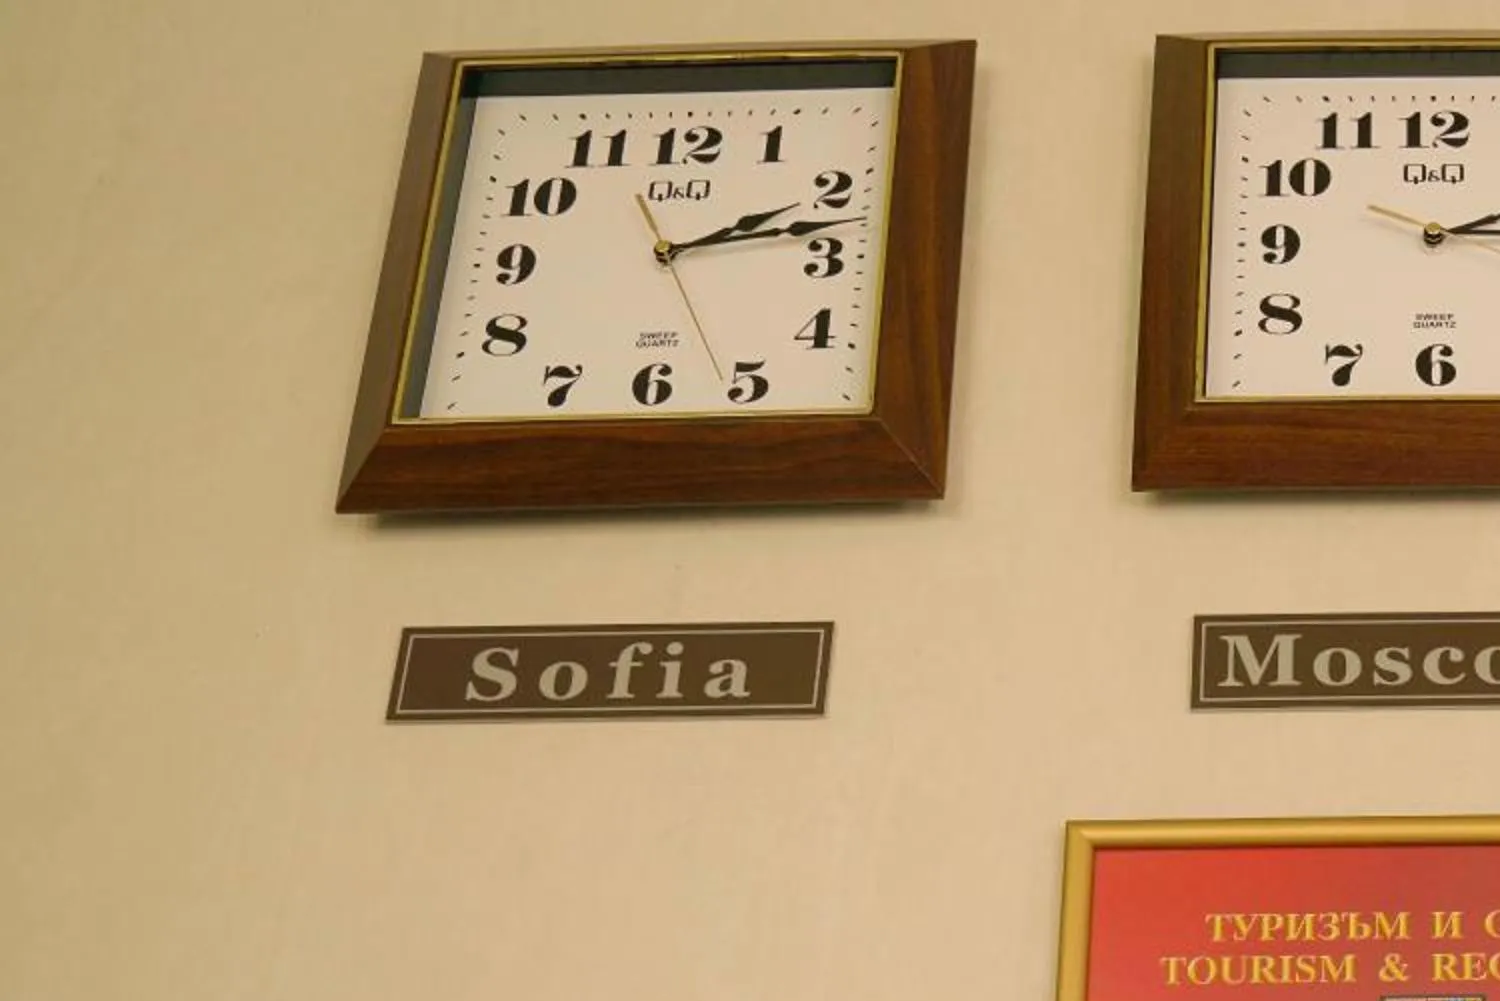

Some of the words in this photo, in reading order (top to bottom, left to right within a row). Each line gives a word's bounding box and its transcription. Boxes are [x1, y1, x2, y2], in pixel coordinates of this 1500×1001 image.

[564, 128, 631, 168] 11
[648, 125, 723, 166] 12
[756, 125, 786, 164] 1
[1314, 111, 1382, 150] 11
[1398, 110, 1470, 149] 12
[501, 177, 577, 217] 10
[813, 170, 853, 209] 2
[1257, 158, 1332, 198] 10
[495, 244, 537, 285] 9
[803, 237, 845, 279] 3
[1260, 224, 1301, 265] 9
[793, 307, 837, 350] 4
[1257, 293, 1303, 335] 8
[481, 313, 528, 357] 8
[542, 364, 583, 407] 7
[631, 363, 673, 405] 6
[726, 360, 770, 403] 5
[1324, 343, 1363, 387] 7
[1415, 343, 1457, 387] 6
[465, 641, 751, 701] Sofia
[1205, 910, 1411, 942] ТУРИЗЪМ
[1431, 912, 1463, 939] И
[1160, 954, 1357, 986] TOURISM
[1378, 953, 1409, 982] &
